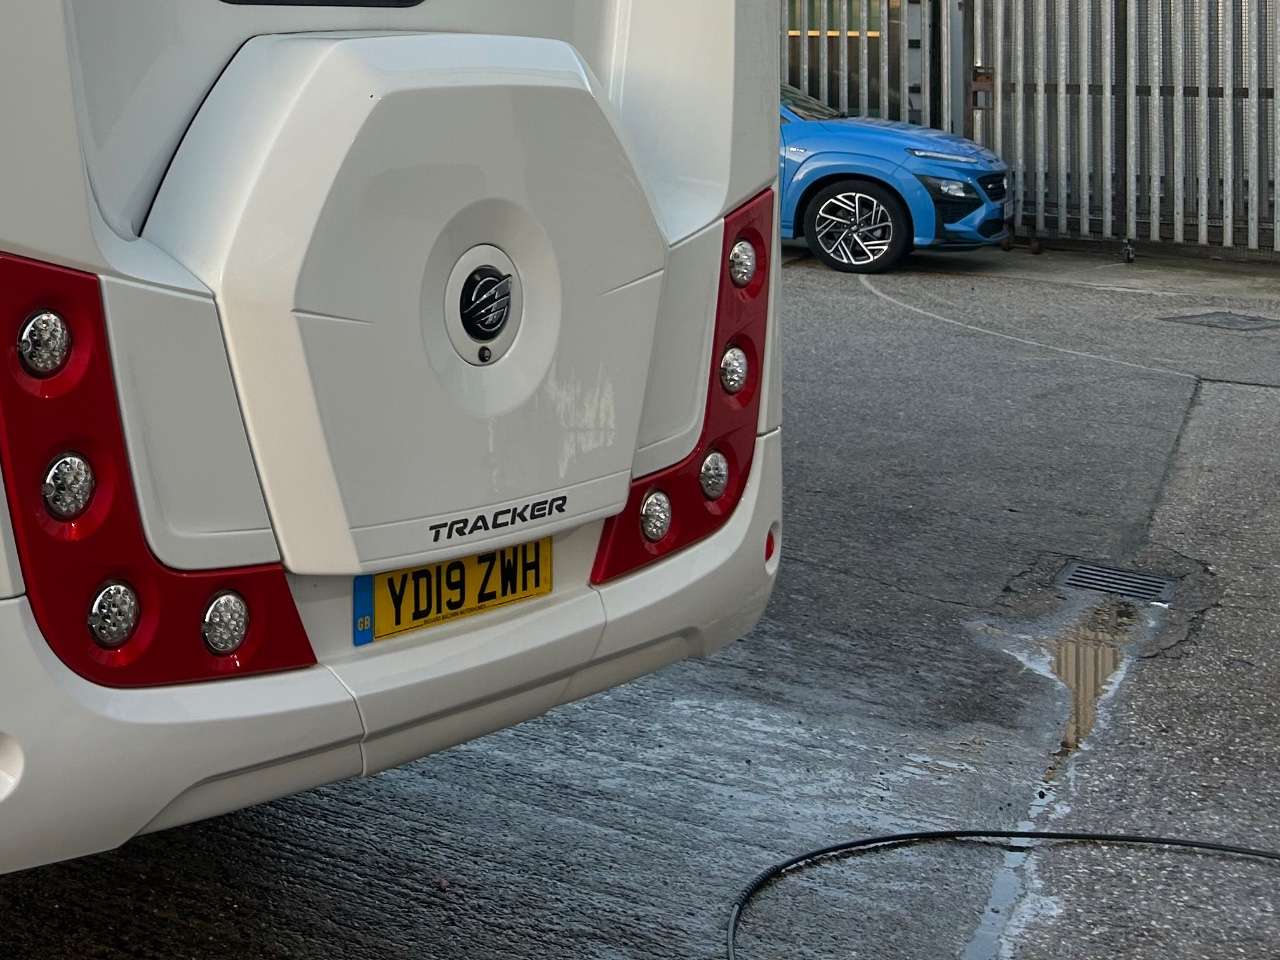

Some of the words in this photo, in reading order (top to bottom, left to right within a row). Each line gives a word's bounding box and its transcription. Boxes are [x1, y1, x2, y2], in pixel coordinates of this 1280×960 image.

[429, 495, 567, 542] TRACKER
[387, 560, 466, 626] YD19
[477, 542, 540, 603] ZWH
[357, 615, 370, 631] GB
